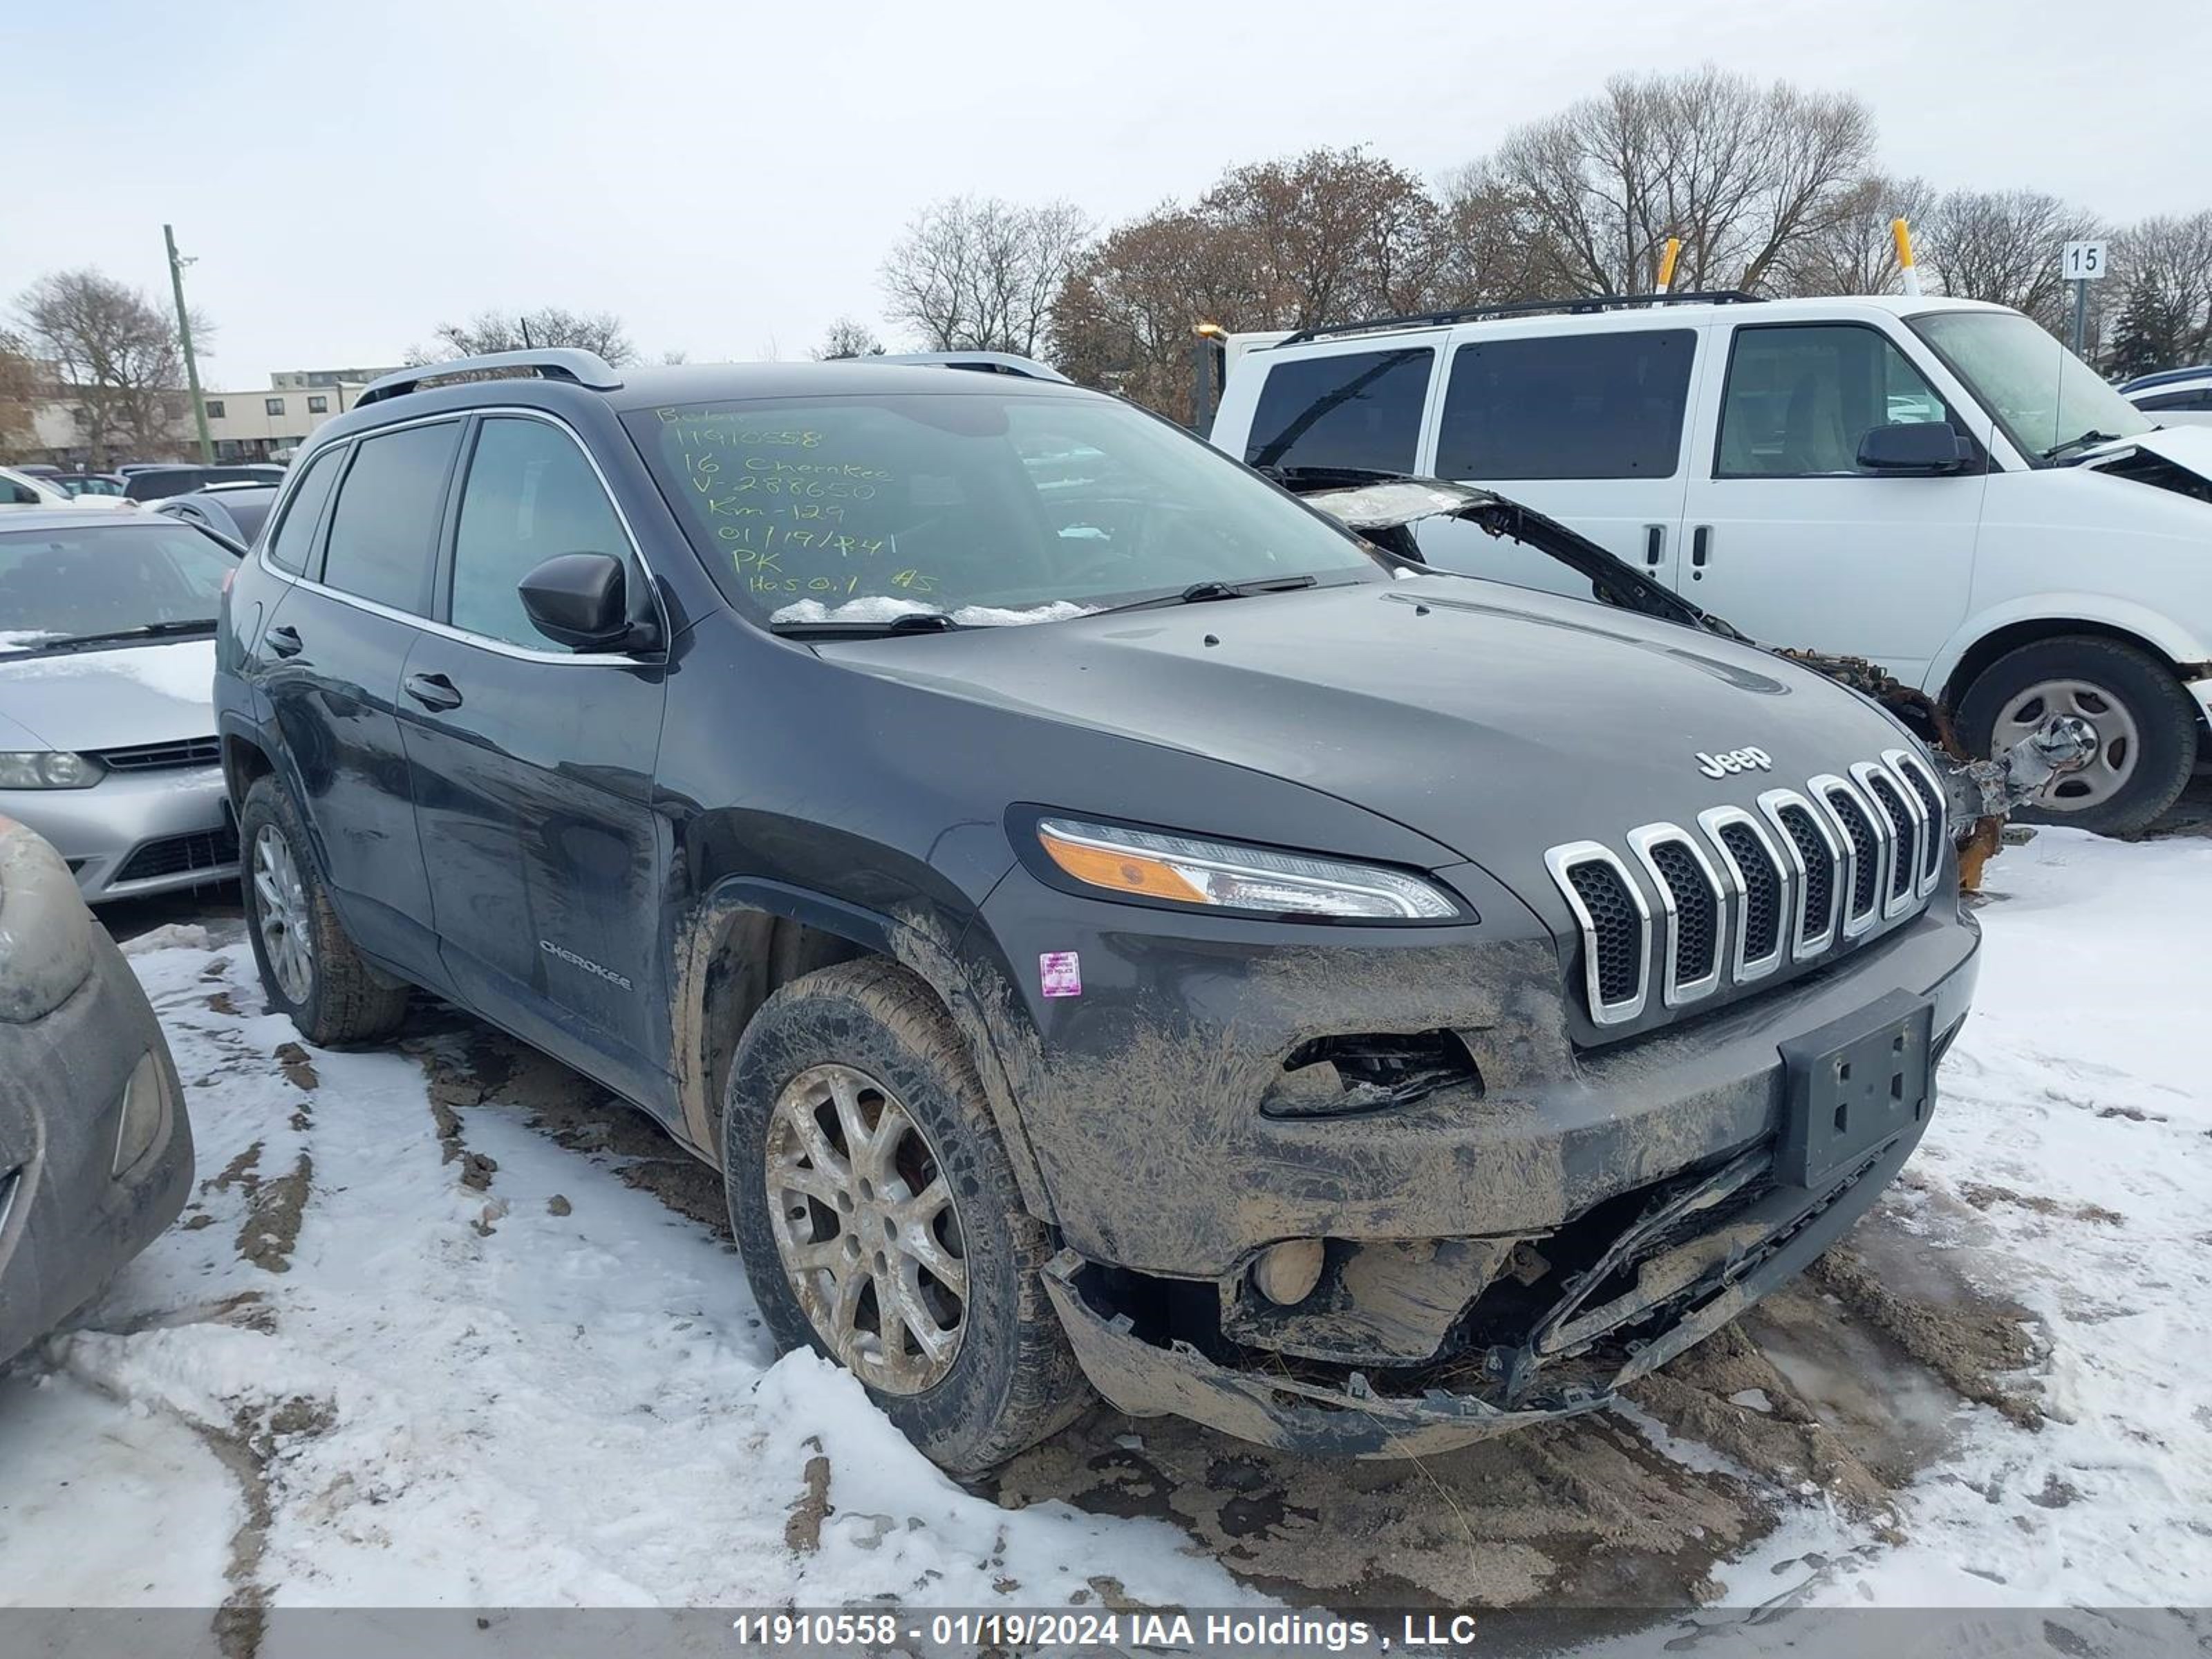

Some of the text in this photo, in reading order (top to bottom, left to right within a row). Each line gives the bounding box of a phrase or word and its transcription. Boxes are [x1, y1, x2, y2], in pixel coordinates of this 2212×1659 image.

[2072, 248, 2097, 271] 15
[677, 429, 821, 448] 11910558
[685, 452, 720, 473] 16
[731, 550, 782, 573] PK
[1695, 746, 1772, 779] Jeep
[539, 939, 633, 992] CHEROKEE
